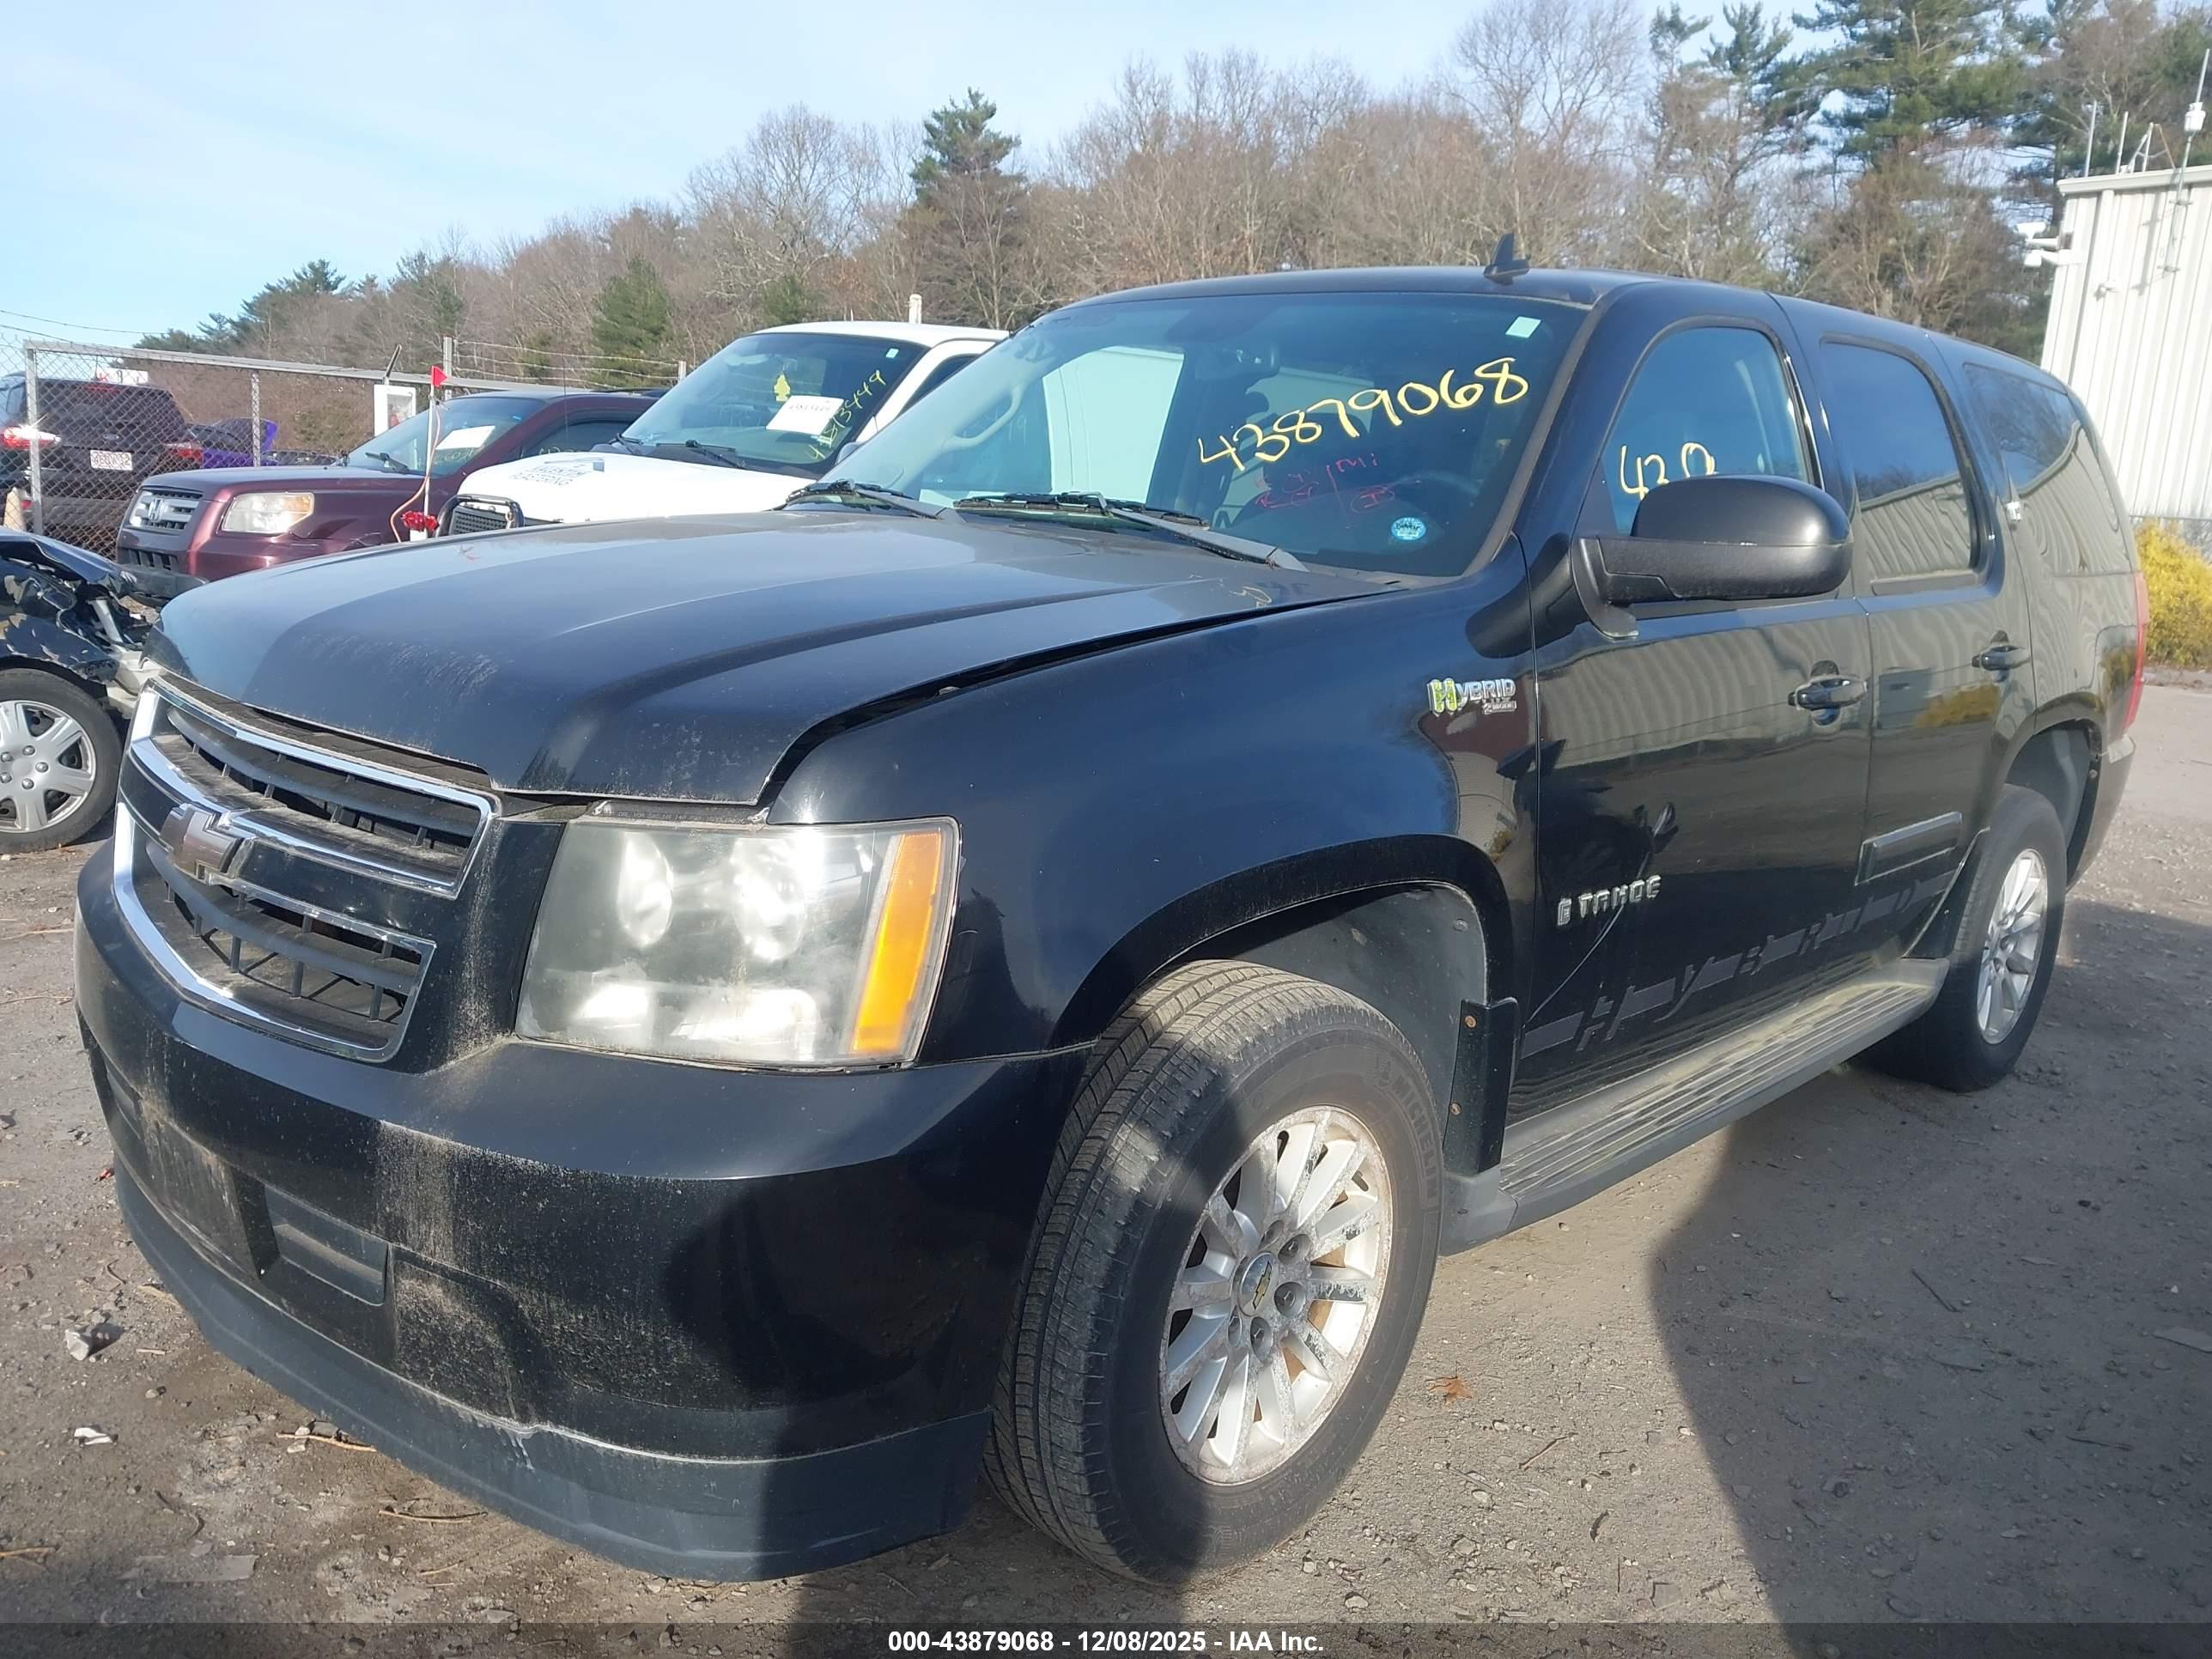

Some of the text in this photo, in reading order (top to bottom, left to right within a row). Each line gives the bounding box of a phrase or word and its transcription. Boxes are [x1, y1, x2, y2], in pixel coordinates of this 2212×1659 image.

[1198, 357, 1529, 471] 43879068
[1578, 874, 1662, 918] TAHOE
[1389, 1071, 1441, 1208] MICHELIN
